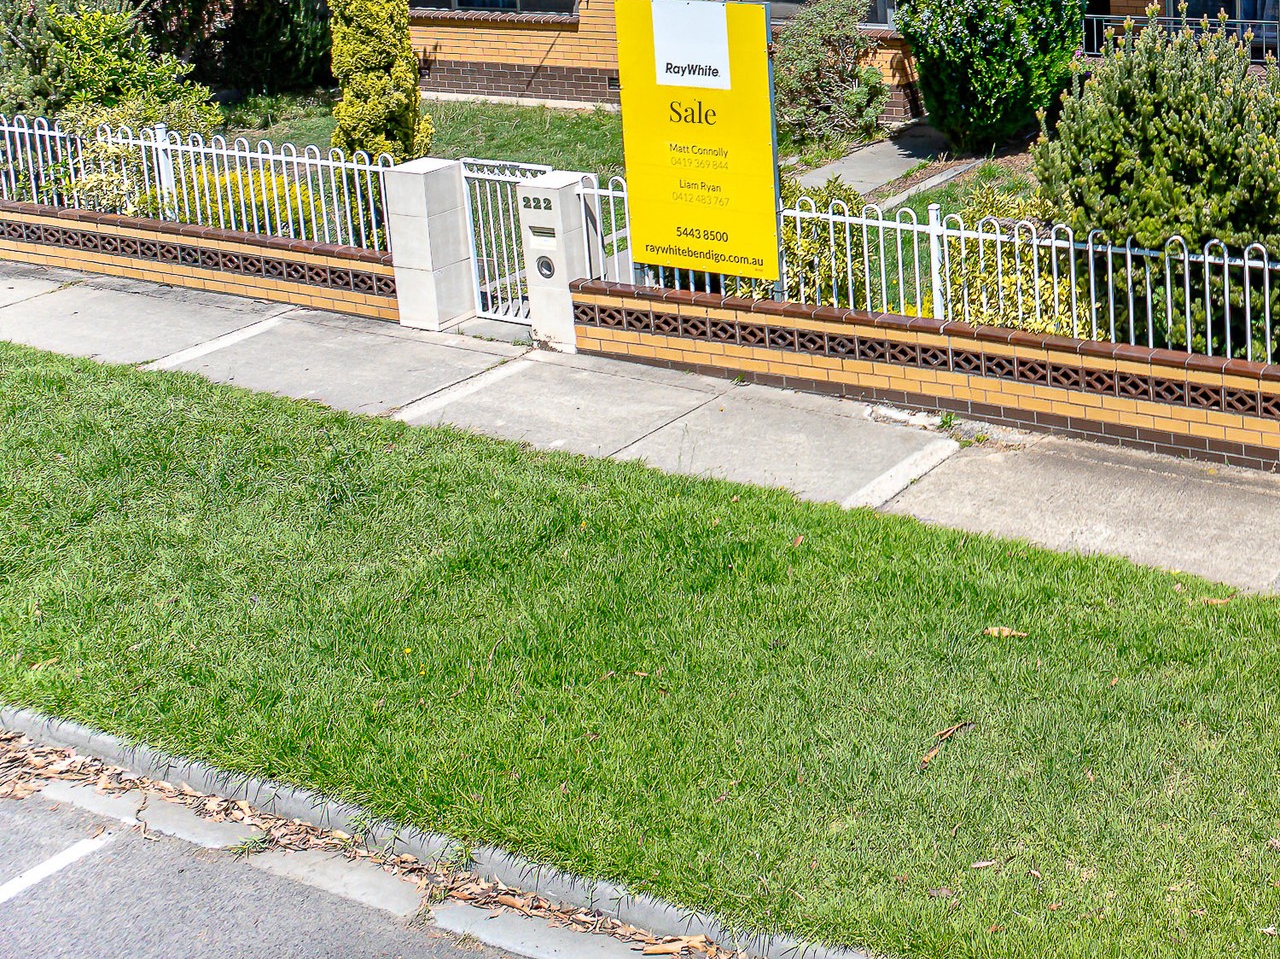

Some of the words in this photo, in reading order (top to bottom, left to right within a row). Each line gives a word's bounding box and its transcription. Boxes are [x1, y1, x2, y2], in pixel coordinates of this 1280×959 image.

[665, 62, 719, 77] RayWhite
[669, 100, 717, 126] Sale
[669, 143, 690, 154] Matt
[691, 145, 729, 158] Connolly
[671, 156, 693, 167] 0419
[712, 160, 729, 170] 844
[679, 179, 699, 190] Liam
[700, 181, 722, 193] Ryan
[522, 196, 553, 210] 222
[672, 191, 694, 203] 0412
[713, 196, 730, 207] 767
[676, 226, 701, 240] 5443
[703, 229, 729, 243] 8500
[645, 243, 764, 267] raywhitebendigo.com.au
